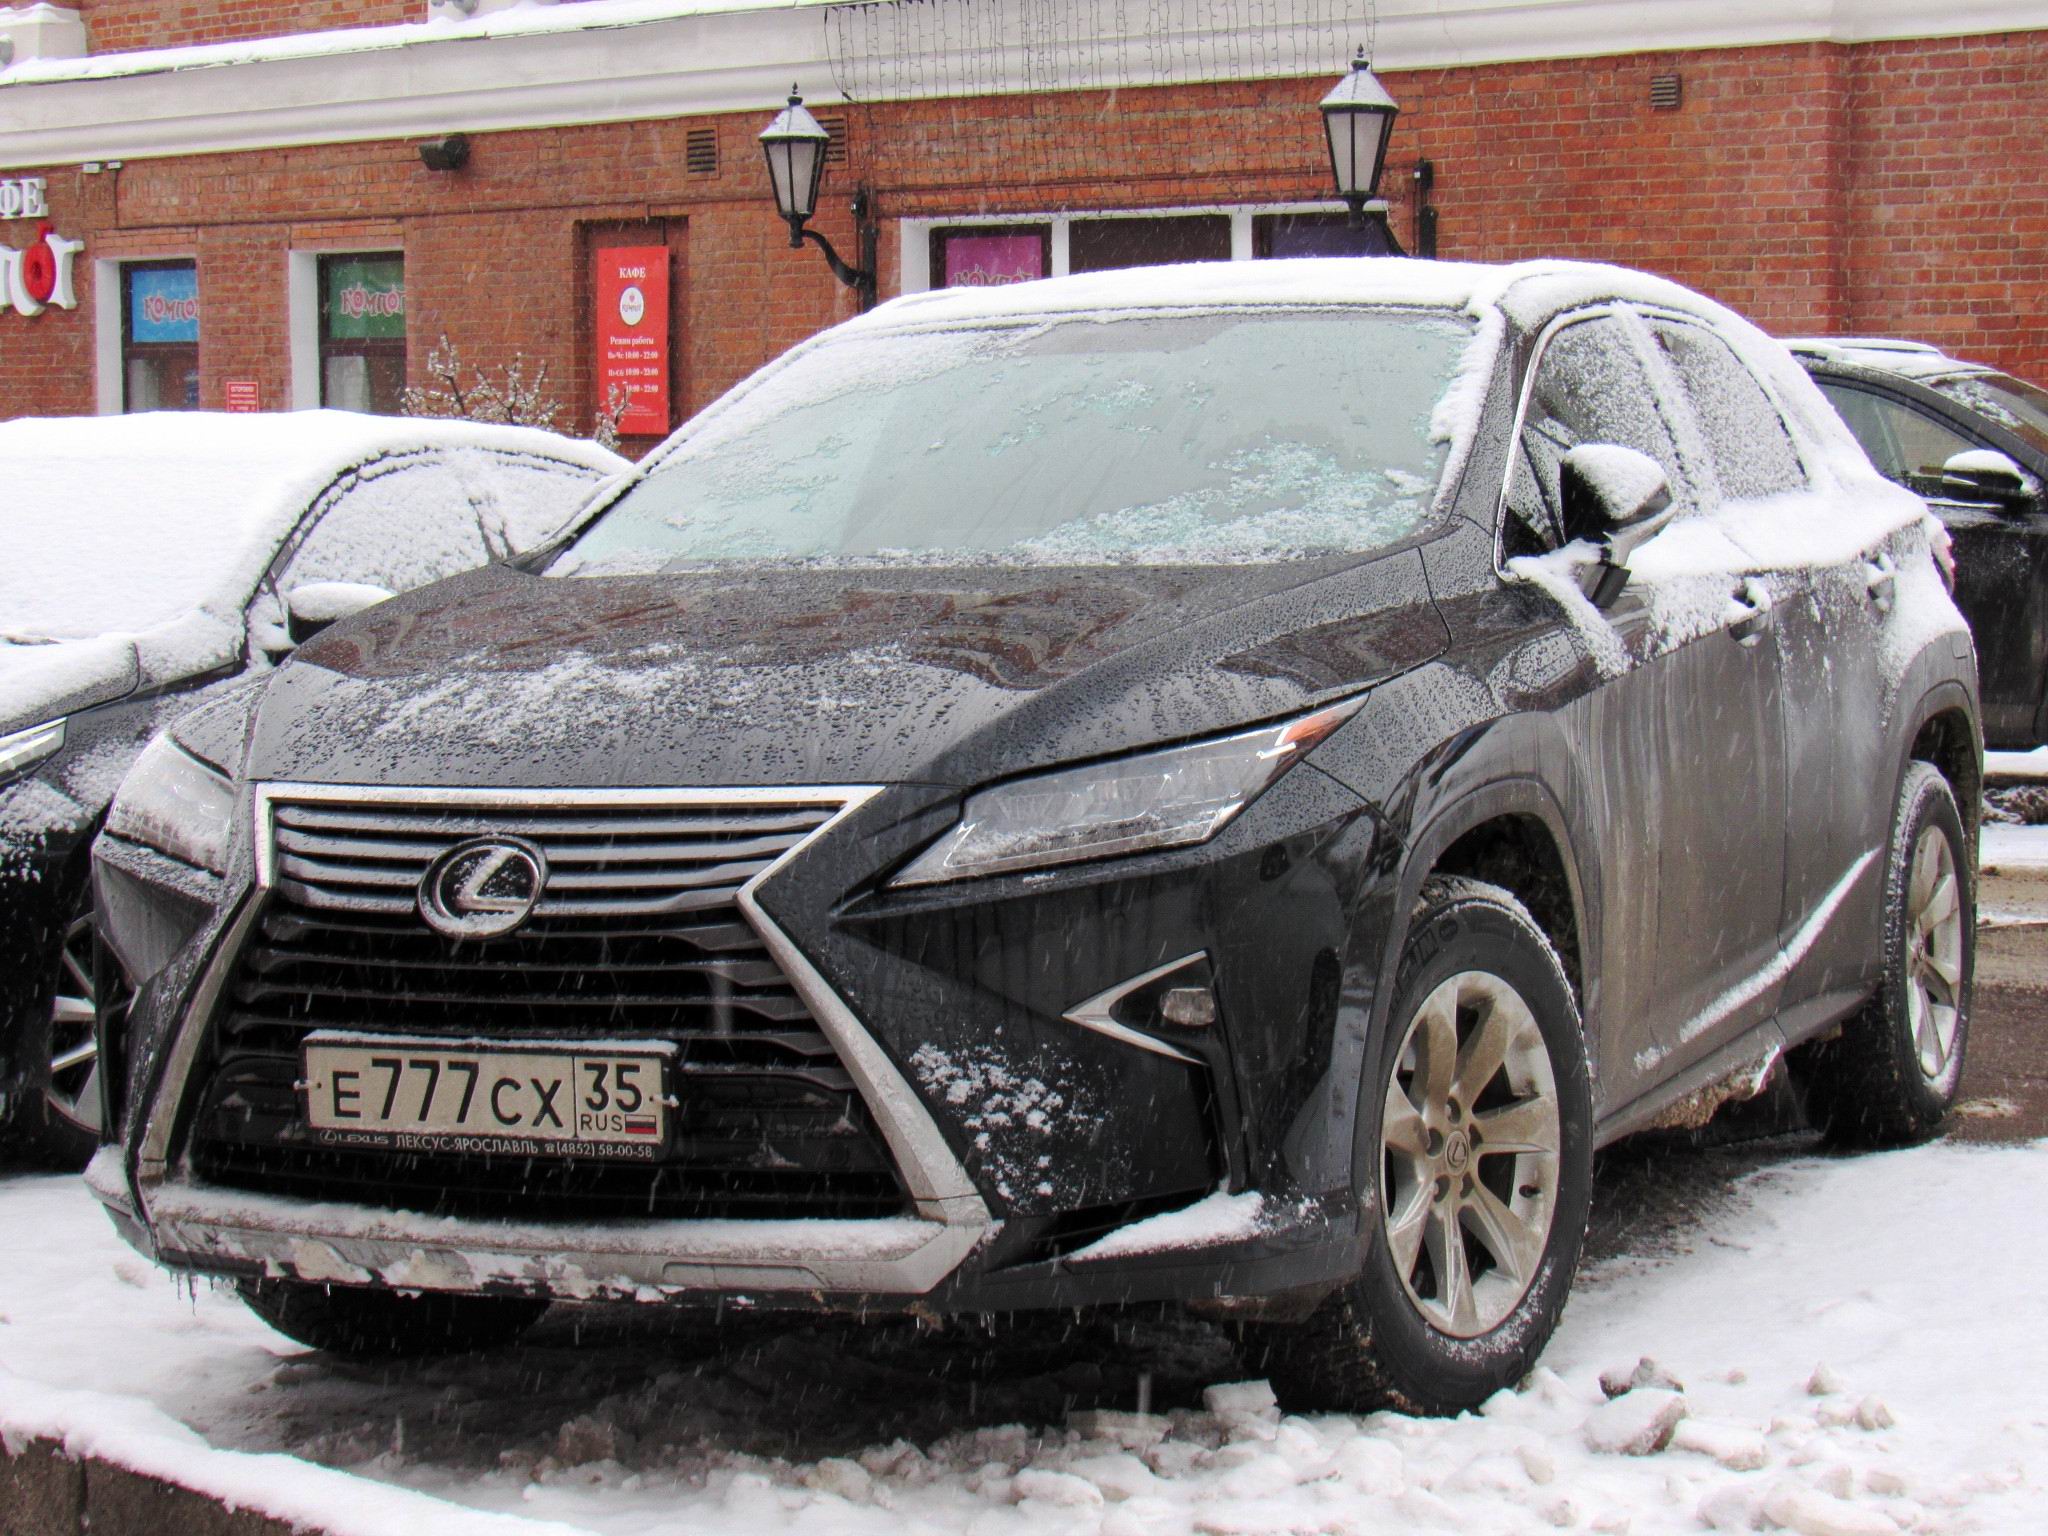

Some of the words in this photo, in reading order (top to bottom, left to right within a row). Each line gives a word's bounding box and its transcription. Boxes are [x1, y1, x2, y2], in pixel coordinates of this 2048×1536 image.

[619, 267, 646, 278] КАФЕ
[631, 336, 654, 347] работы
[584, 1062, 642, 1113] 35
[580, 1113, 623, 1132] RUS
[338, 1135, 389, 1144] LEXUS
[396, 1134, 539, 1154] ЛЕКСУС-ЯРОСЛАВЛЬ
[556, 1143, 596, 1158] (4852)
[598, 1145, 653, 1158] 58-00-58
